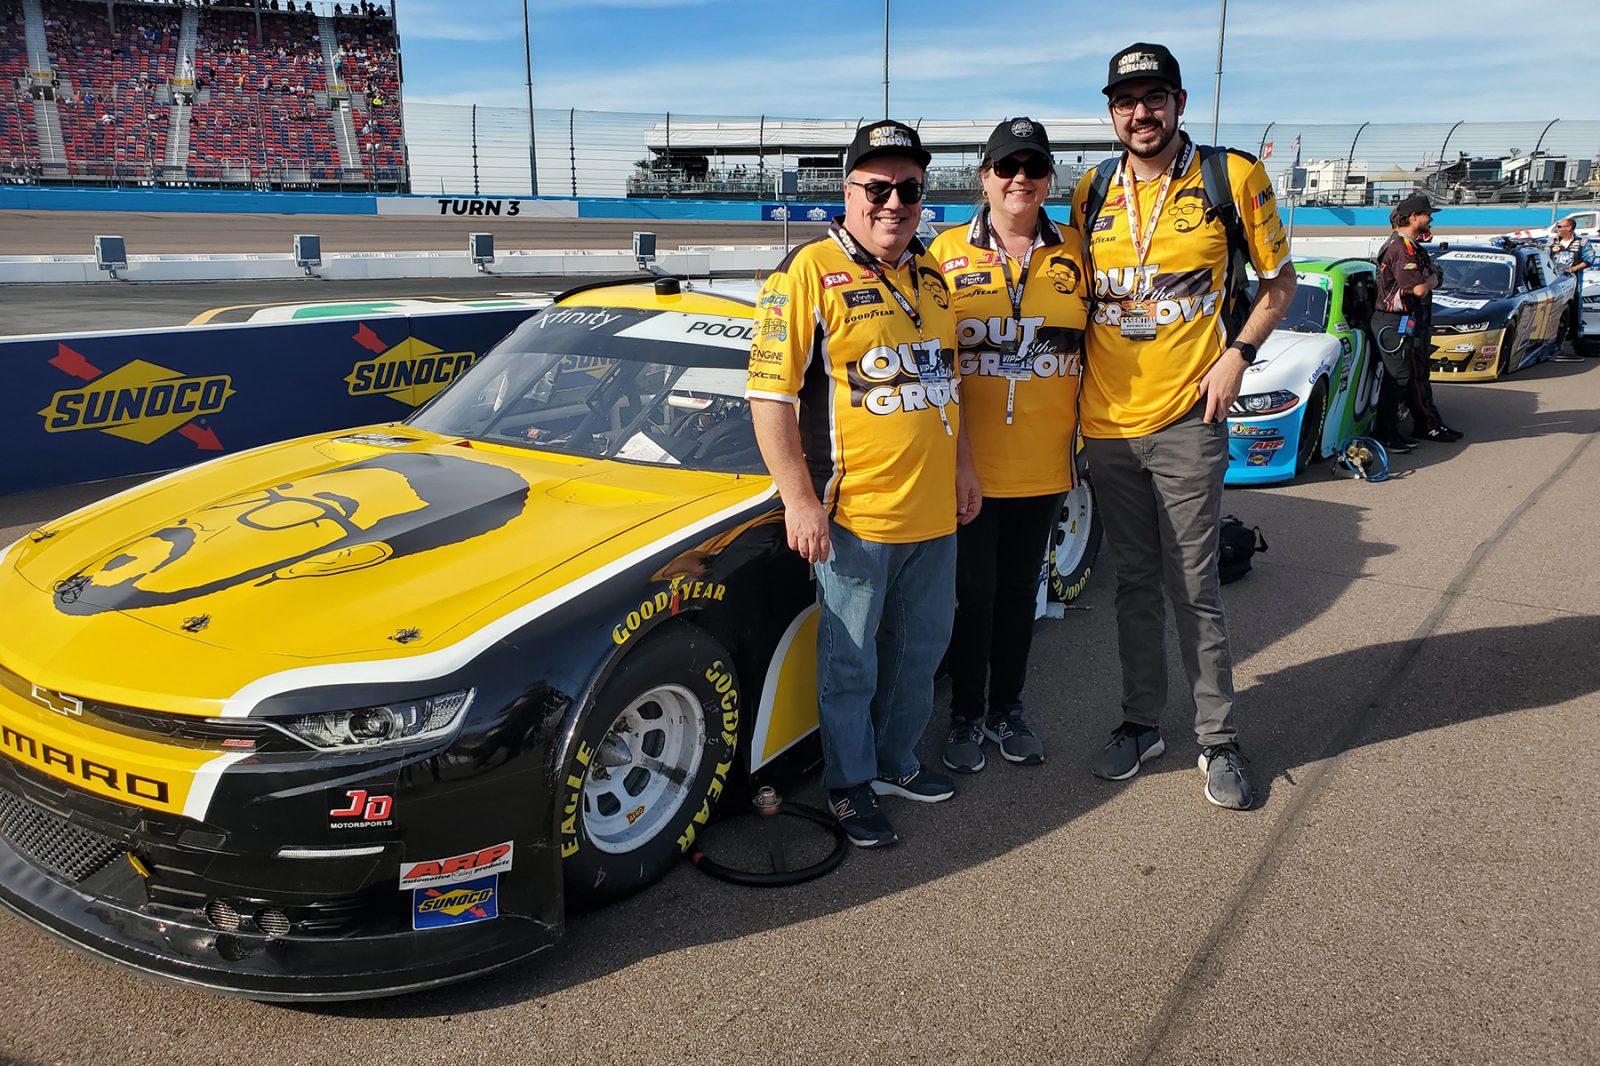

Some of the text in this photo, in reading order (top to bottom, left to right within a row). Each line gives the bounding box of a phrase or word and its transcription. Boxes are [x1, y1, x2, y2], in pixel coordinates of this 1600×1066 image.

[1120, 52, 1142, 65] OUT
[874, 126, 897, 137] OUT
[438, 200, 520, 215] TURN 3
[1454, 252, 1506, 261] CLEMENTS
[944, 259, 965, 272] SEM
[825, 273, 850, 286] SEM
[852, 294, 876, 303] xfinity
[1150, 286, 1176, 300] the
[533, 308, 622, 331] xfinity
[845, 309, 895, 324] GOODYEAR
[957, 317, 1045, 359] OUT
[1003, 354, 1016, 363] VIP
[51, 379, 227, 428] SUNOCO
[1251, 441, 1283, 449] ARP
[612, 575, 727, 646] GOODYEAR
[676, 660, 740, 854] GOODYEAR
[330, 790, 393, 820] JD
[561, 740, 595, 859] EAGLE
[330, 820, 392, 829] MOTORSPORTS
[402, 844, 511, 879] ARP
[473, 860, 510, 873] products
[421, 889, 491, 911] SUNOCO
